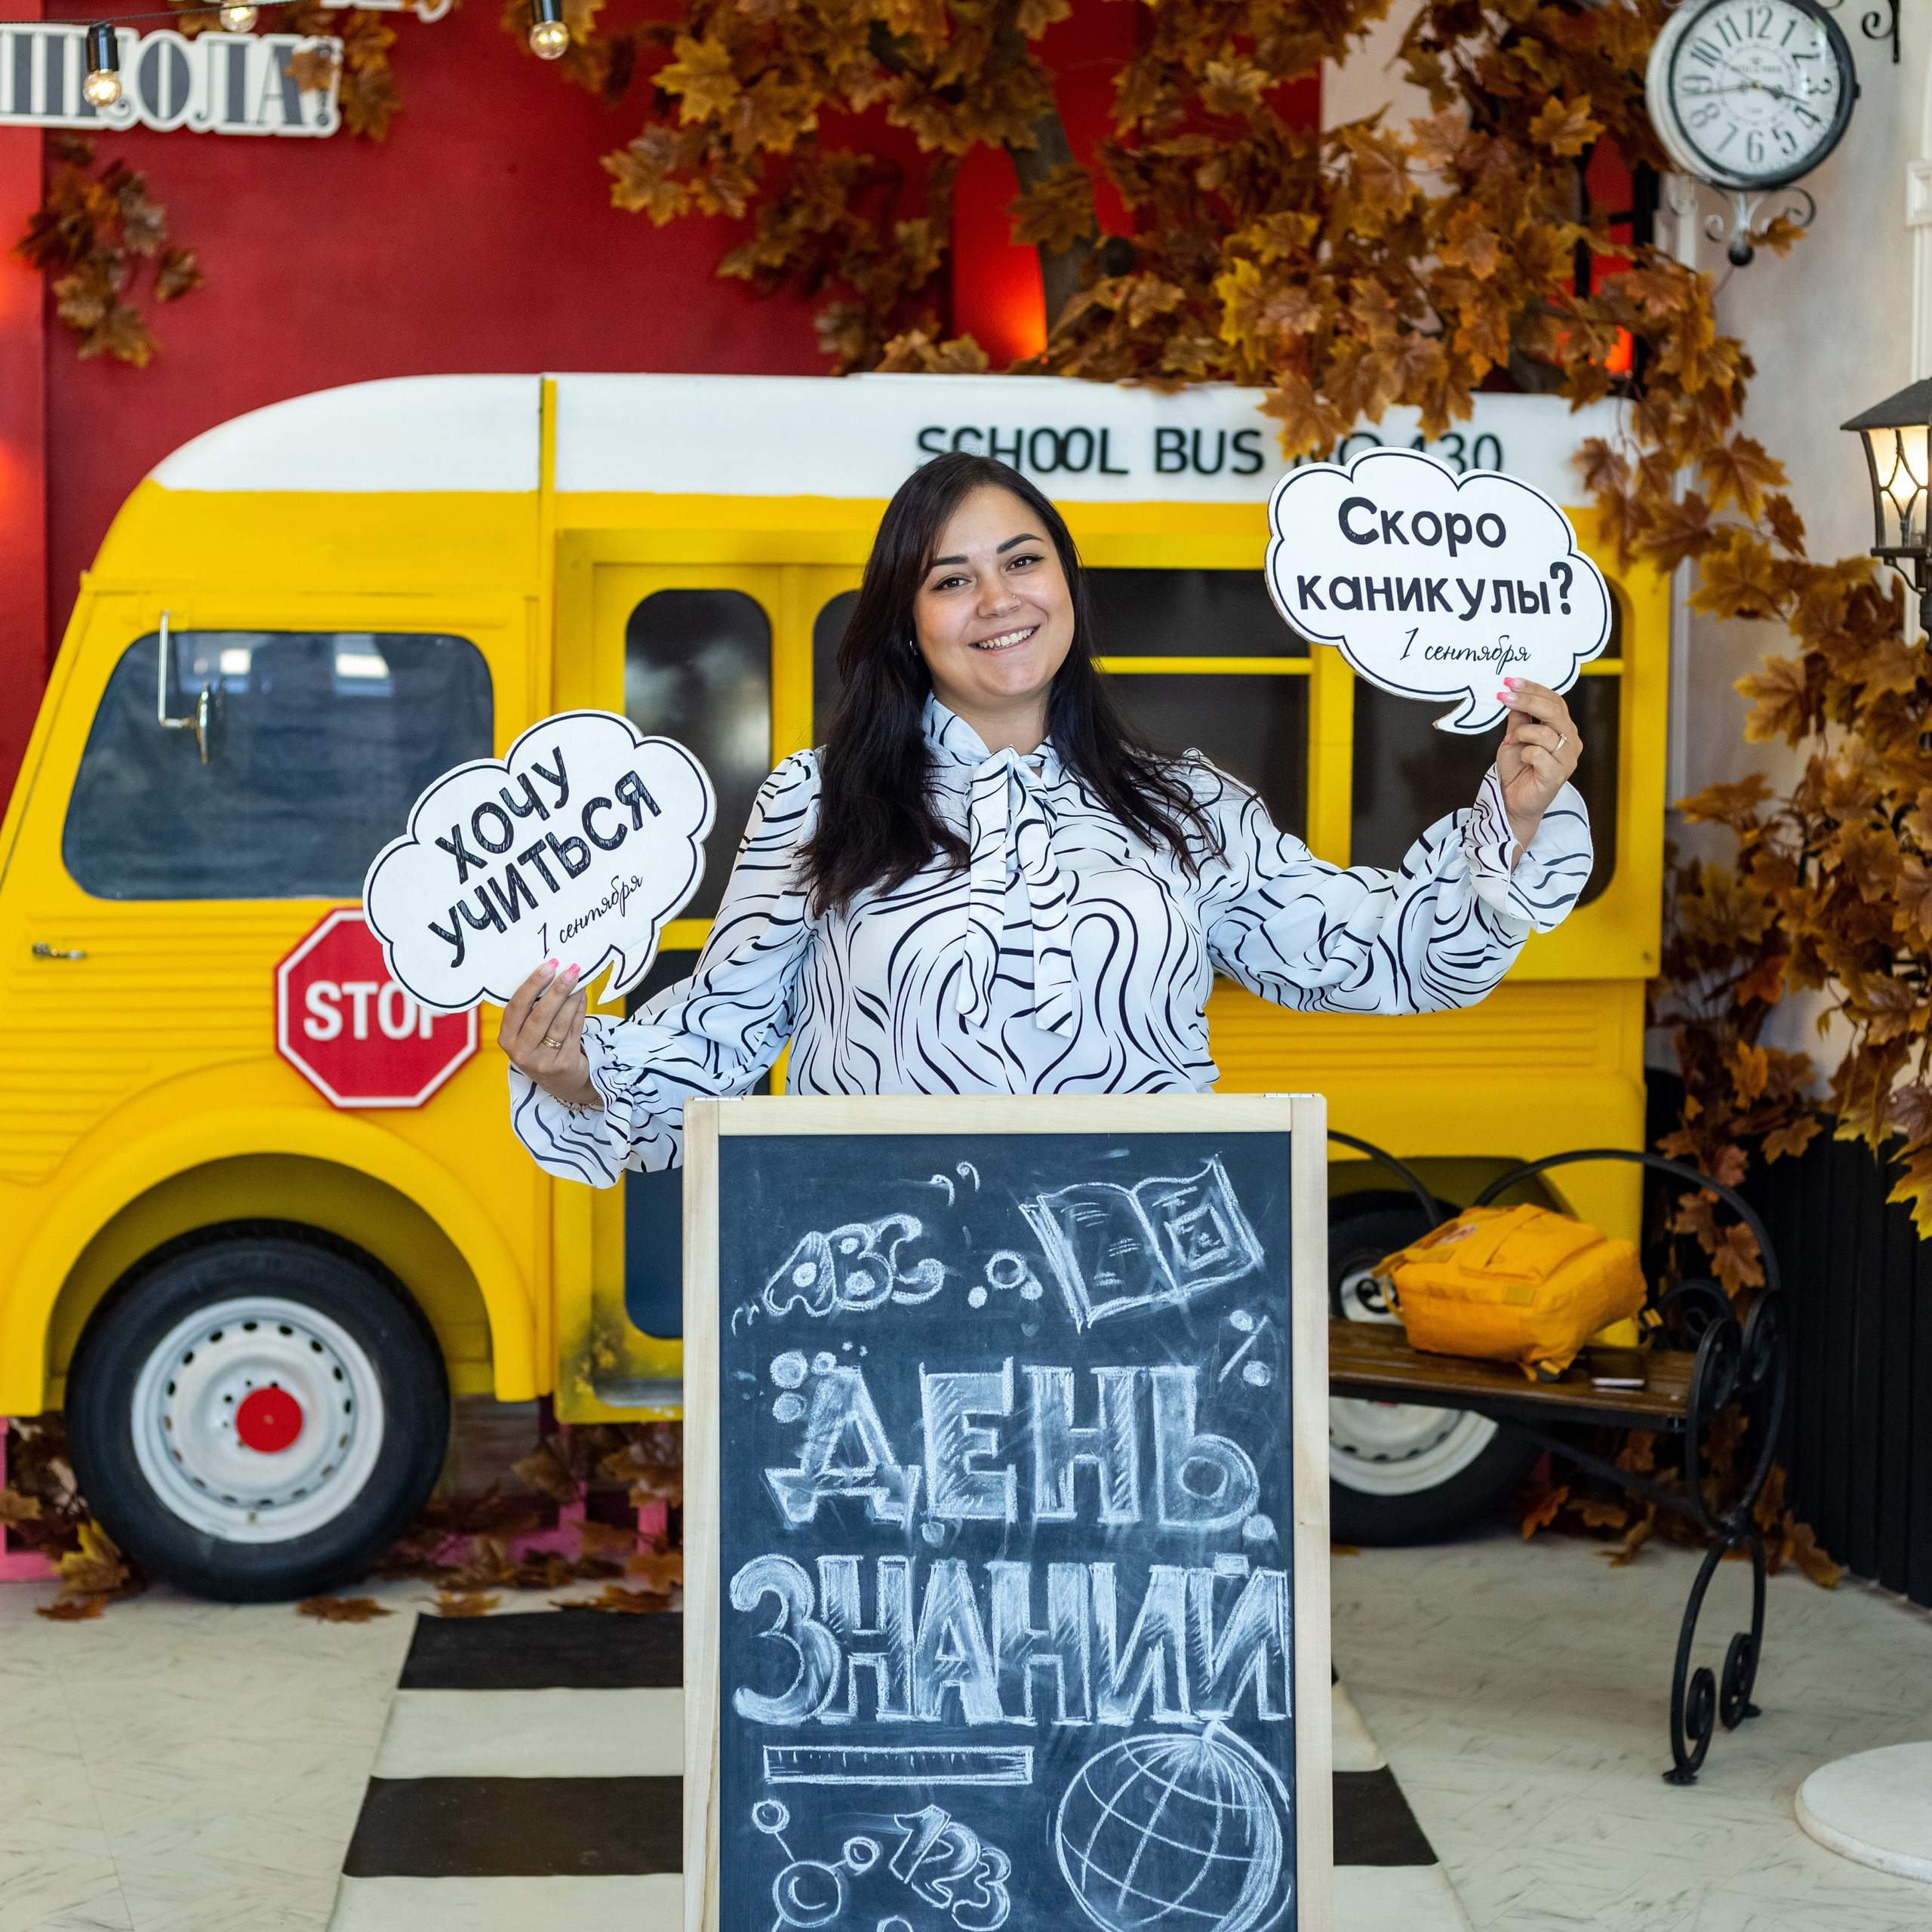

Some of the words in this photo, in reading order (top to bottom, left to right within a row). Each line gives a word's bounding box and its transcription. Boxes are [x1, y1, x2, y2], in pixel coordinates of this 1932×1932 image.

[1715, 15, 1742, 48] 11
[1746, 5, 1774, 38] 12
[1780, 19, 1797, 47] 1
[1690, 36, 1723, 69] 10
[1792, 40, 1822, 69] 2
[1681, 74, 1714, 94] 9
[1805, 77, 1832, 95] 3
[1690, 102, 1721, 128] 8
[1794, 106, 1822, 129] 4
[1718, 121, 1739, 152] 7
[1747, 129, 1764, 164] 6
[1771, 122, 1798, 155] 5
[1155, 427, 1265, 475] BUS
[1338, 497, 1507, 558] Скоро
[1297, 561, 1574, 622] каникулы?
[1400, 627, 1419, 661] 1
[1424, 635, 1532, 675] сентября
[434, 746, 570, 885] ХОЧУ
[427, 770, 662, 968] УЧИТЬСЯ
[537, 922, 550, 959] 1
[559, 875, 643, 943] сентября
[763, 1212, 946, 1318] ABC
[764, 1356, 1260, 1530] ДЕНЬ
[729, 1553, 1292, 1727] ЗНАНИЙ
[888, 1804, 1012, 1931] 123
